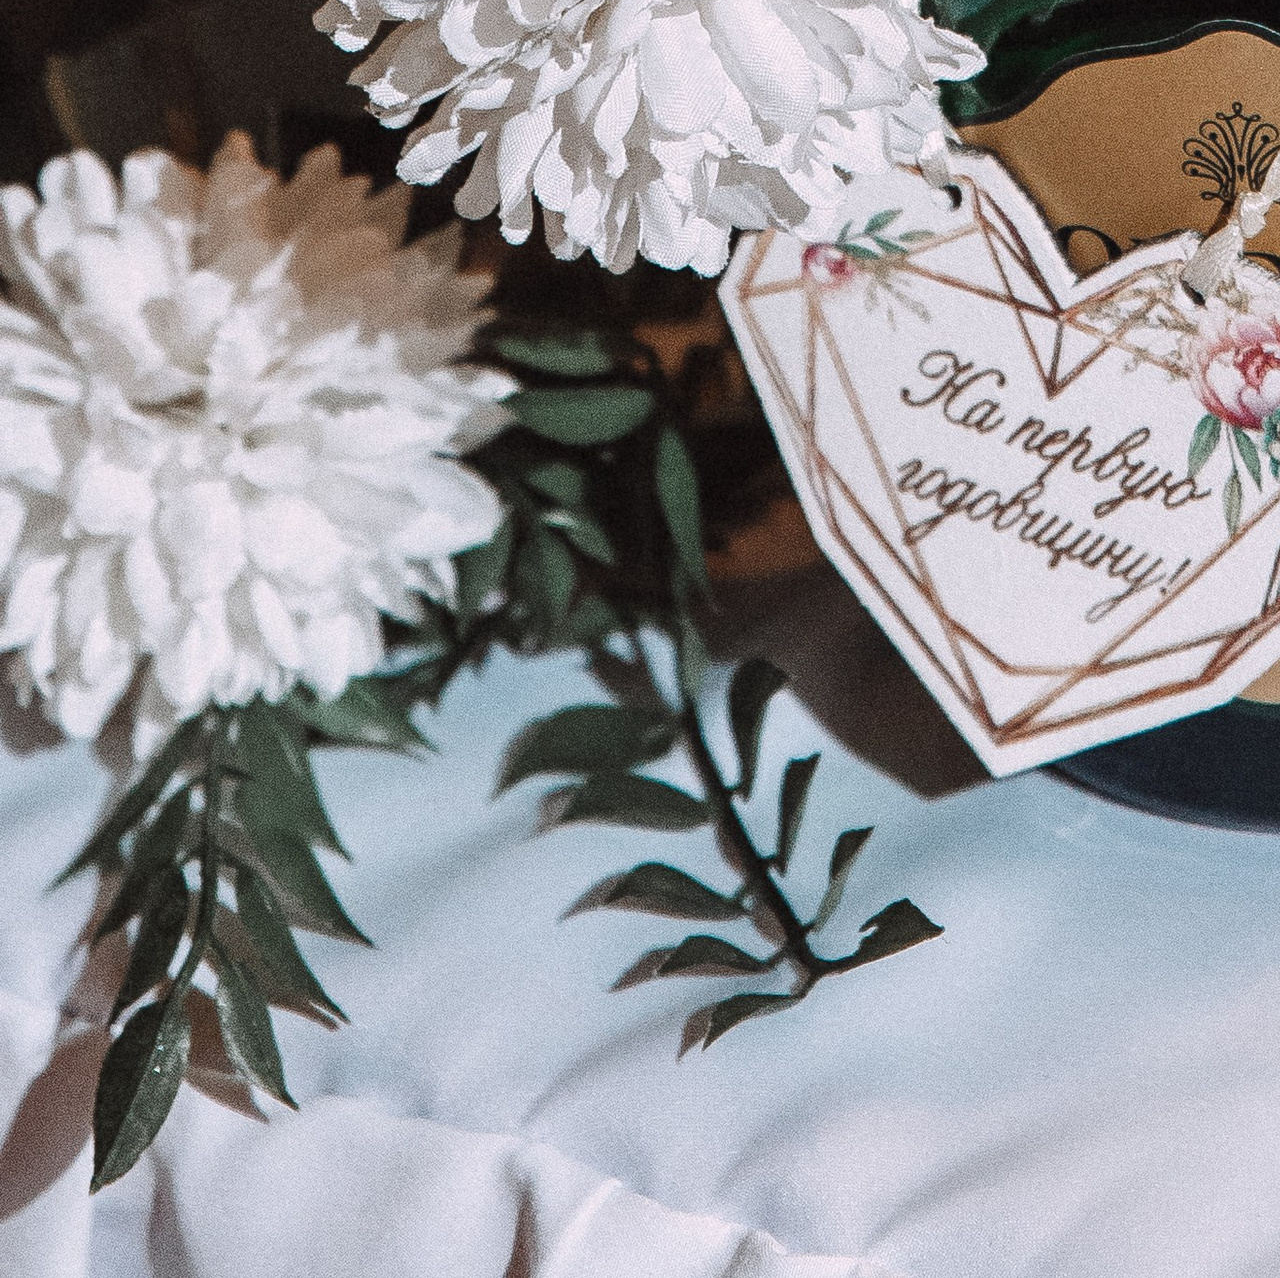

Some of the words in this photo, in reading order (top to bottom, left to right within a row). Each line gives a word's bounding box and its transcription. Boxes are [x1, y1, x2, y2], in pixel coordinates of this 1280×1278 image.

[900, 349, 1006, 434] На
[1005, 416, 1212, 519] первую
[897, 458, 1192, 623] годовщину!
